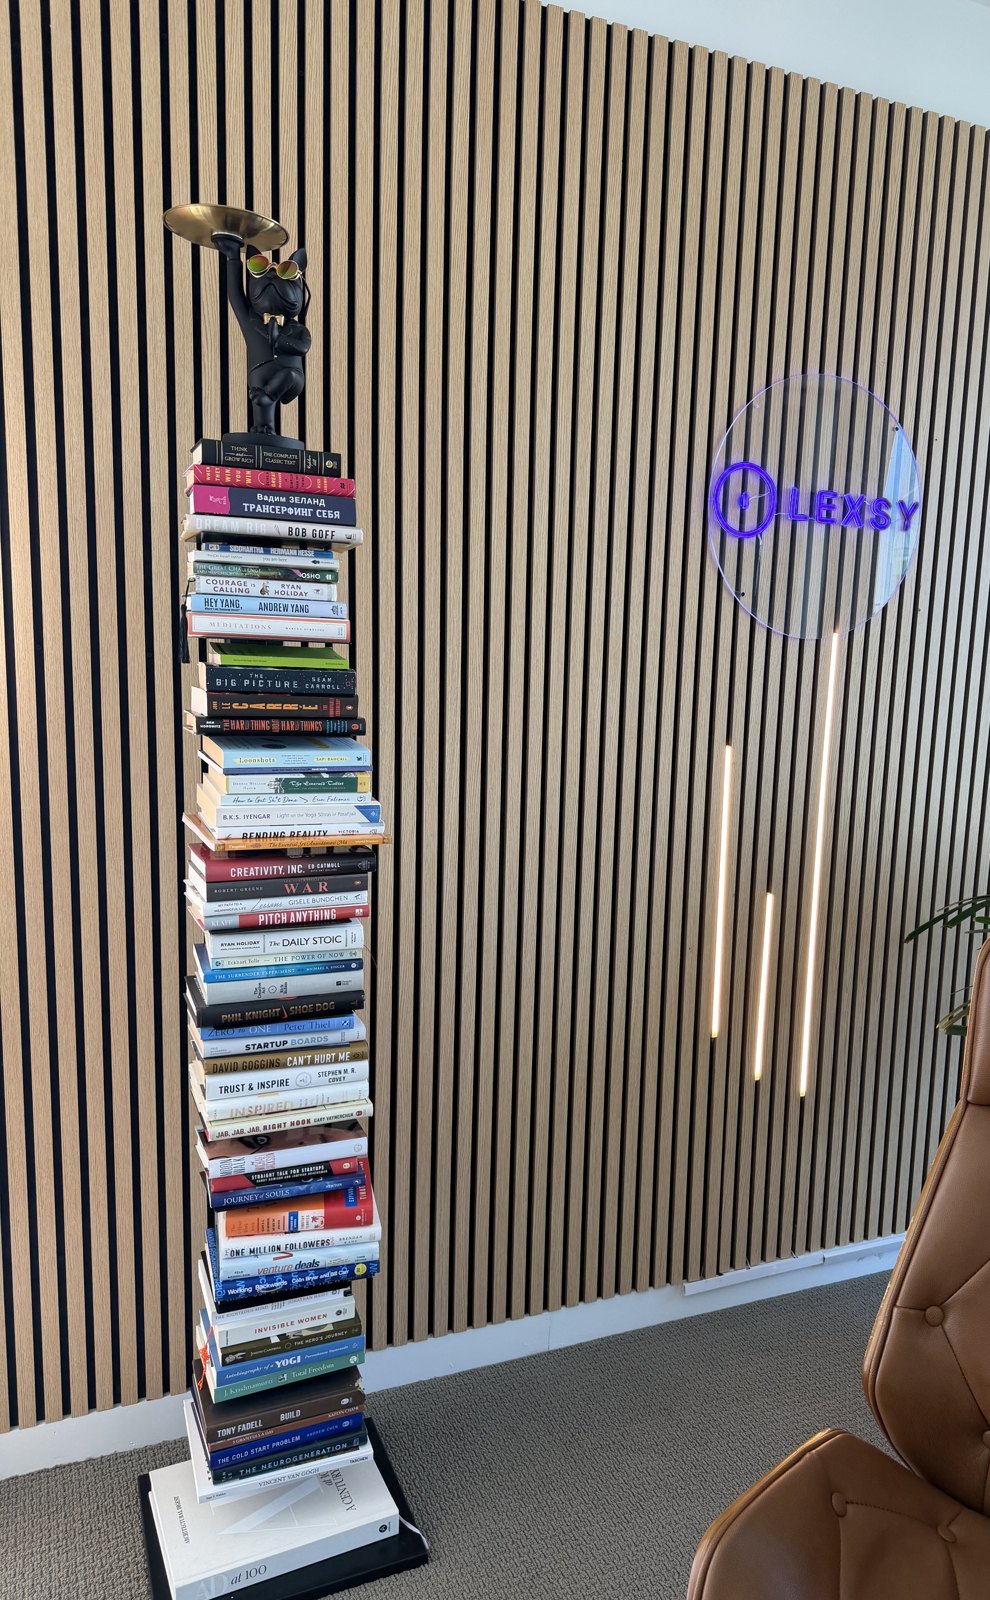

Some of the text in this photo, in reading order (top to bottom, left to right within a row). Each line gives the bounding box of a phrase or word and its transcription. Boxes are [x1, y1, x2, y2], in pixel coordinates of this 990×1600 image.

[257, 493, 326, 507] Вадим ЗЕЛАНД
[243, 503, 340, 519] ТРАНСЕРФИНГ СЕБЯ
[788, 487, 919, 532] LEXSY
[196, 518, 335, 540] DREAM BIG BOB GOFF
[230, 545, 264, 553] SIDDHARTHA
[270, 548, 297, 556] HERMANN
[206, 579, 248, 587] COURAGE
[204, 598, 218, 607] HEY
[220, 599, 242, 610] YANG,
[258, 602, 289, 612] ANDREW
[291, 603, 309, 613] YANG
[209, 621, 272, 630] MEDITATIONS
[244, 680, 298, 688] PICTURE
[231, 720, 249, 730] HARD
[251, 720, 270, 730] THING
[281, 721, 299, 731] HARD
[300, 721, 322, 731] THINGS
[242, 830, 328, 839] BENDING REALITY
[230, 865, 285, 877] CREATIVITY,
[288, 864, 305, 874] INC.
[284, 881, 328, 894] WAR
[259, 909, 336, 925] PITCH ANYTHING
[282, 937, 310, 947] DAILY
[312, 935, 342, 945] STOIC
[221, 1002, 335, 1023] PHIL KNIGHT SHOE DOG
[208, 1021, 330, 1037] ZERO ONE Peter Thiel
[245, 1036, 328, 1051] STARTUP BOARDS
[212, 1052, 350, 1074] DAVID GOGGINS CAN'T HURT ME
[219, 1084, 245, 1095] TRUST
[257, 1079, 290, 1090] INSPIRE
[318, 1070, 343, 1078] STEPHEN
[263, 1122, 287, 1131] RIGHT
[290, 1119, 311, 1127] HOOK
[222, 1190, 290, 1206] JOURNEY SOULS
[230, 1239, 330, 1257] ONE MILLION FOLLOWERS
[257, 1264, 293, 1274] venture
[295, 1259, 320, 1270] deals
[228, 1286, 252, 1295] Working
[255, 1280, 287, 1292] Backwards
[226, 1309, 253, 1317] RIGHTEOUS
[254, 1313, 328, 1333] INVISIBLE WOMEN
[325, 1331, 347, 1339] JOURNEY
[225, 1356, 301, 1379] Autobiography YOGI
[292, 1370, 307, 1378] Total
[308, 1363, 334, 1373] Freedom
[217, 1410, 300, 1438] TONY FADELL BUILD
[232, 1452, 248, 1460] COLD
[250, 1445, 270, 1454] START
[272, 1436, 300, 1448] PROBLEM
[239, 1467, 256, 1475] THE
[262, 1443, 348, 1470] NEUROGENERATION
[258, 1477, 286, 1487] VINCENT
[286, 1473, 300, 1481] VAN
[301, 1468, 320, 1478] GOGH
[231, 1573, 241, 1585] at
[245, 1565, 267, 1579] 100
